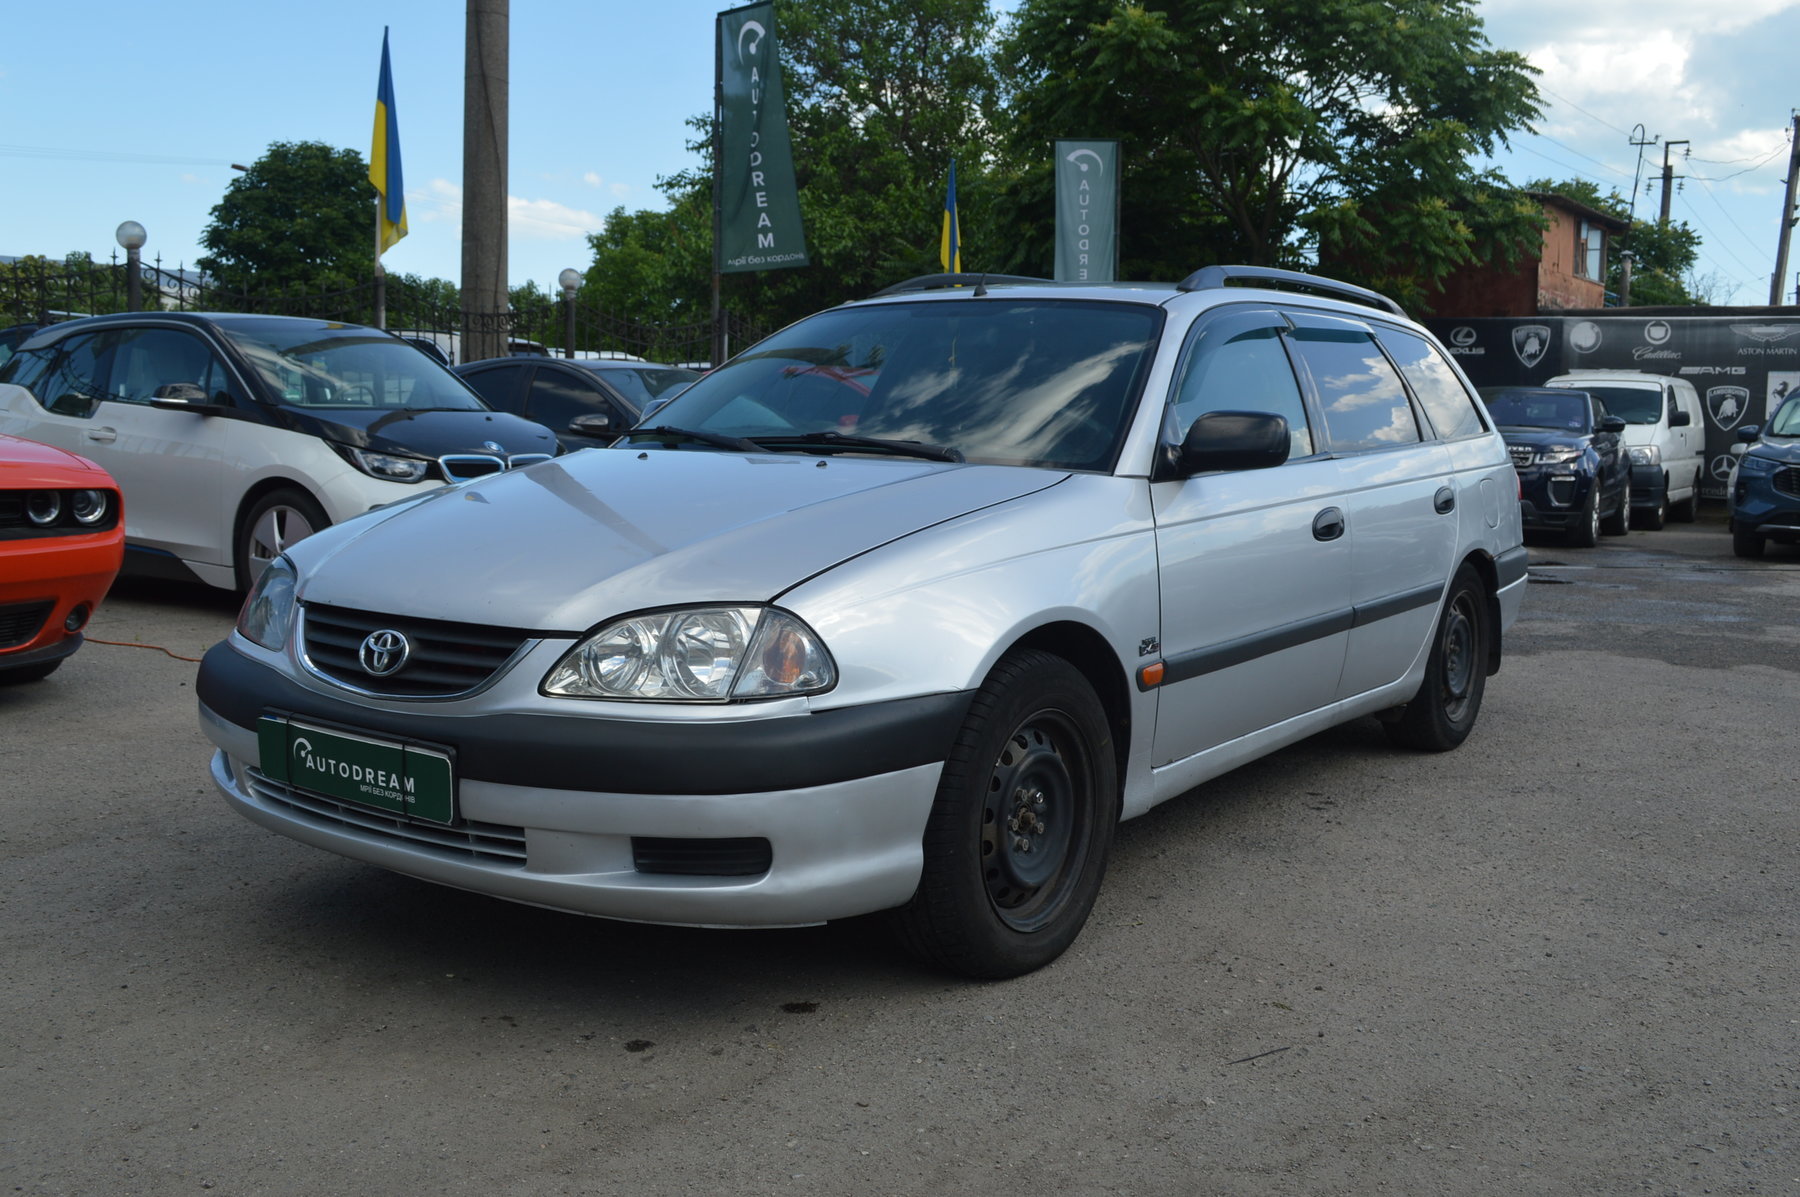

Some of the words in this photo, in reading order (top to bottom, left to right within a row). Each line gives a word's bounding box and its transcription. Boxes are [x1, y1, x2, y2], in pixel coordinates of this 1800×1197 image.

[750, 66, 775, 249] AUODREAM
[1449, 346, 1485, 355] EXUS
[1737, 347, 1764, 356] ASTON
[1766, 347, 1797, 356] MARTIN
[1700, 366, 1746, 375] AMG
[306, 753, 415, 793] AUTODREAM
[373, 787, 384, 797] БЕЗ
